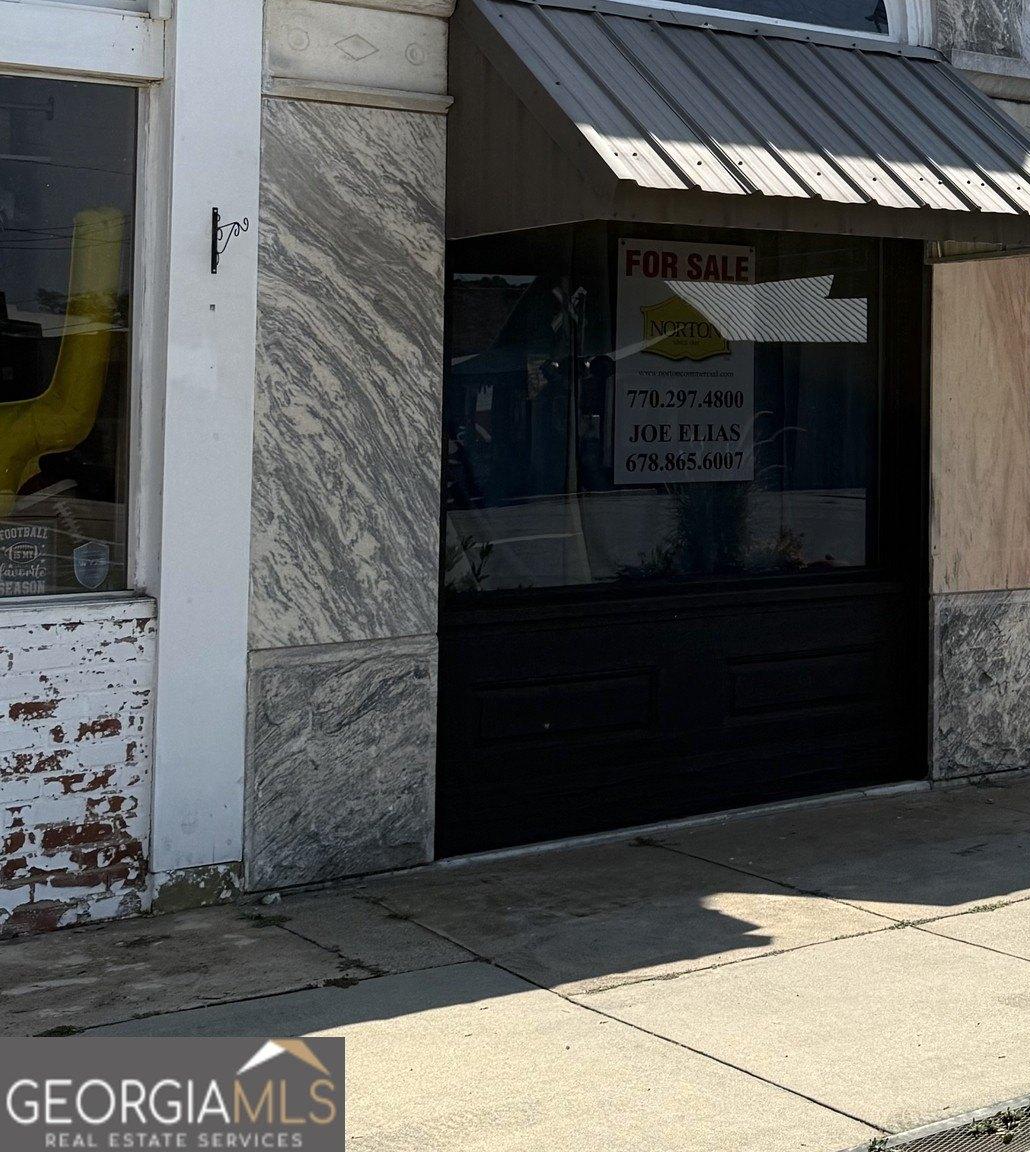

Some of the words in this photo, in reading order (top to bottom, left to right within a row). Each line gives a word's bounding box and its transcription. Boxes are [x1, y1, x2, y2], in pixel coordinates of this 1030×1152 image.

[625, 249, 678, 278] FOR
[687, 253, 749, 281] SALE
[626, 389, 744, 409] 770.297.4800
[629, 424, 671, 443] JOE
[678, 423, 741, 442] ELIAS
[626, 452, 744, 472] 678.865.6007
[0, 527, 48, 540] FOOTBALL
[13, 551, 22, 560] IS
[22, 550, 34, 559] MY
[0, 580, 46, 596] SEASON
